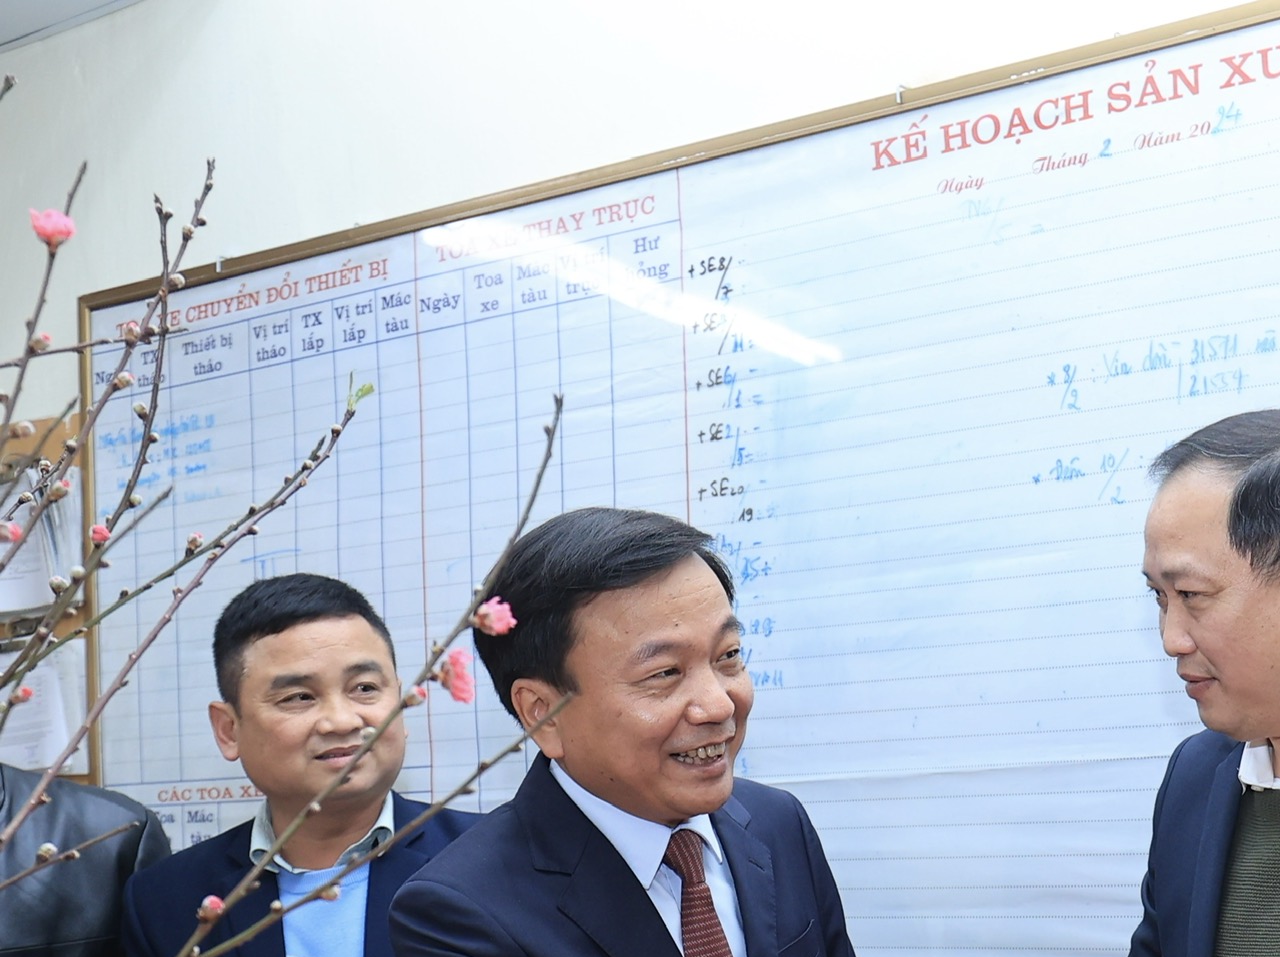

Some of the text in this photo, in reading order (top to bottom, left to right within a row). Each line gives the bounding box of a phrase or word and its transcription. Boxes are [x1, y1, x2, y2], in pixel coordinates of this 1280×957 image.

[870, 115, 930, 171] KẾ
[940, 90, 1095, 154] HOẠCH
[1106, 59, 1204, 115] SẢN
[936, 174, 985, 195] Ngày
[1031, 150, 1090, 175] Tháng
[1133, 130, 1182, 151] Năm
[522, 211, 587, 239] THAY
[592, 195, 656, 226] TRỤC
[632, 236, 661, 255] Hư
[473, 271, 504, 290] Toa
[515, 261, 550, 282] Mác
[185, 283, 260, 324] CHUYỂN
[266, 272, 300, 302] ĐỔI
[304, 259, 364, 293] THIẾT
[368, 258, 389, 283] BỊ
[381, 291, 412, 311] Mác
[520, 285, 548, 305] tàu
[333, 298, 375, 325] Vị trí
[419, 290, 461, 314] Ngày
[479, 299, 500, 314] xe
[301, 311, 323, 328] TX
[385, 316, 410, 333] tàu
[252, 318, 290, 342] Vị trí
[256, 342, 287, 362] tháo
[193, 357, 223, 377] tháo
[157, 786, 192, 802] CÁC
[196, 787, 233, 800] TOA
[187, 809, 213, 823] Mác
